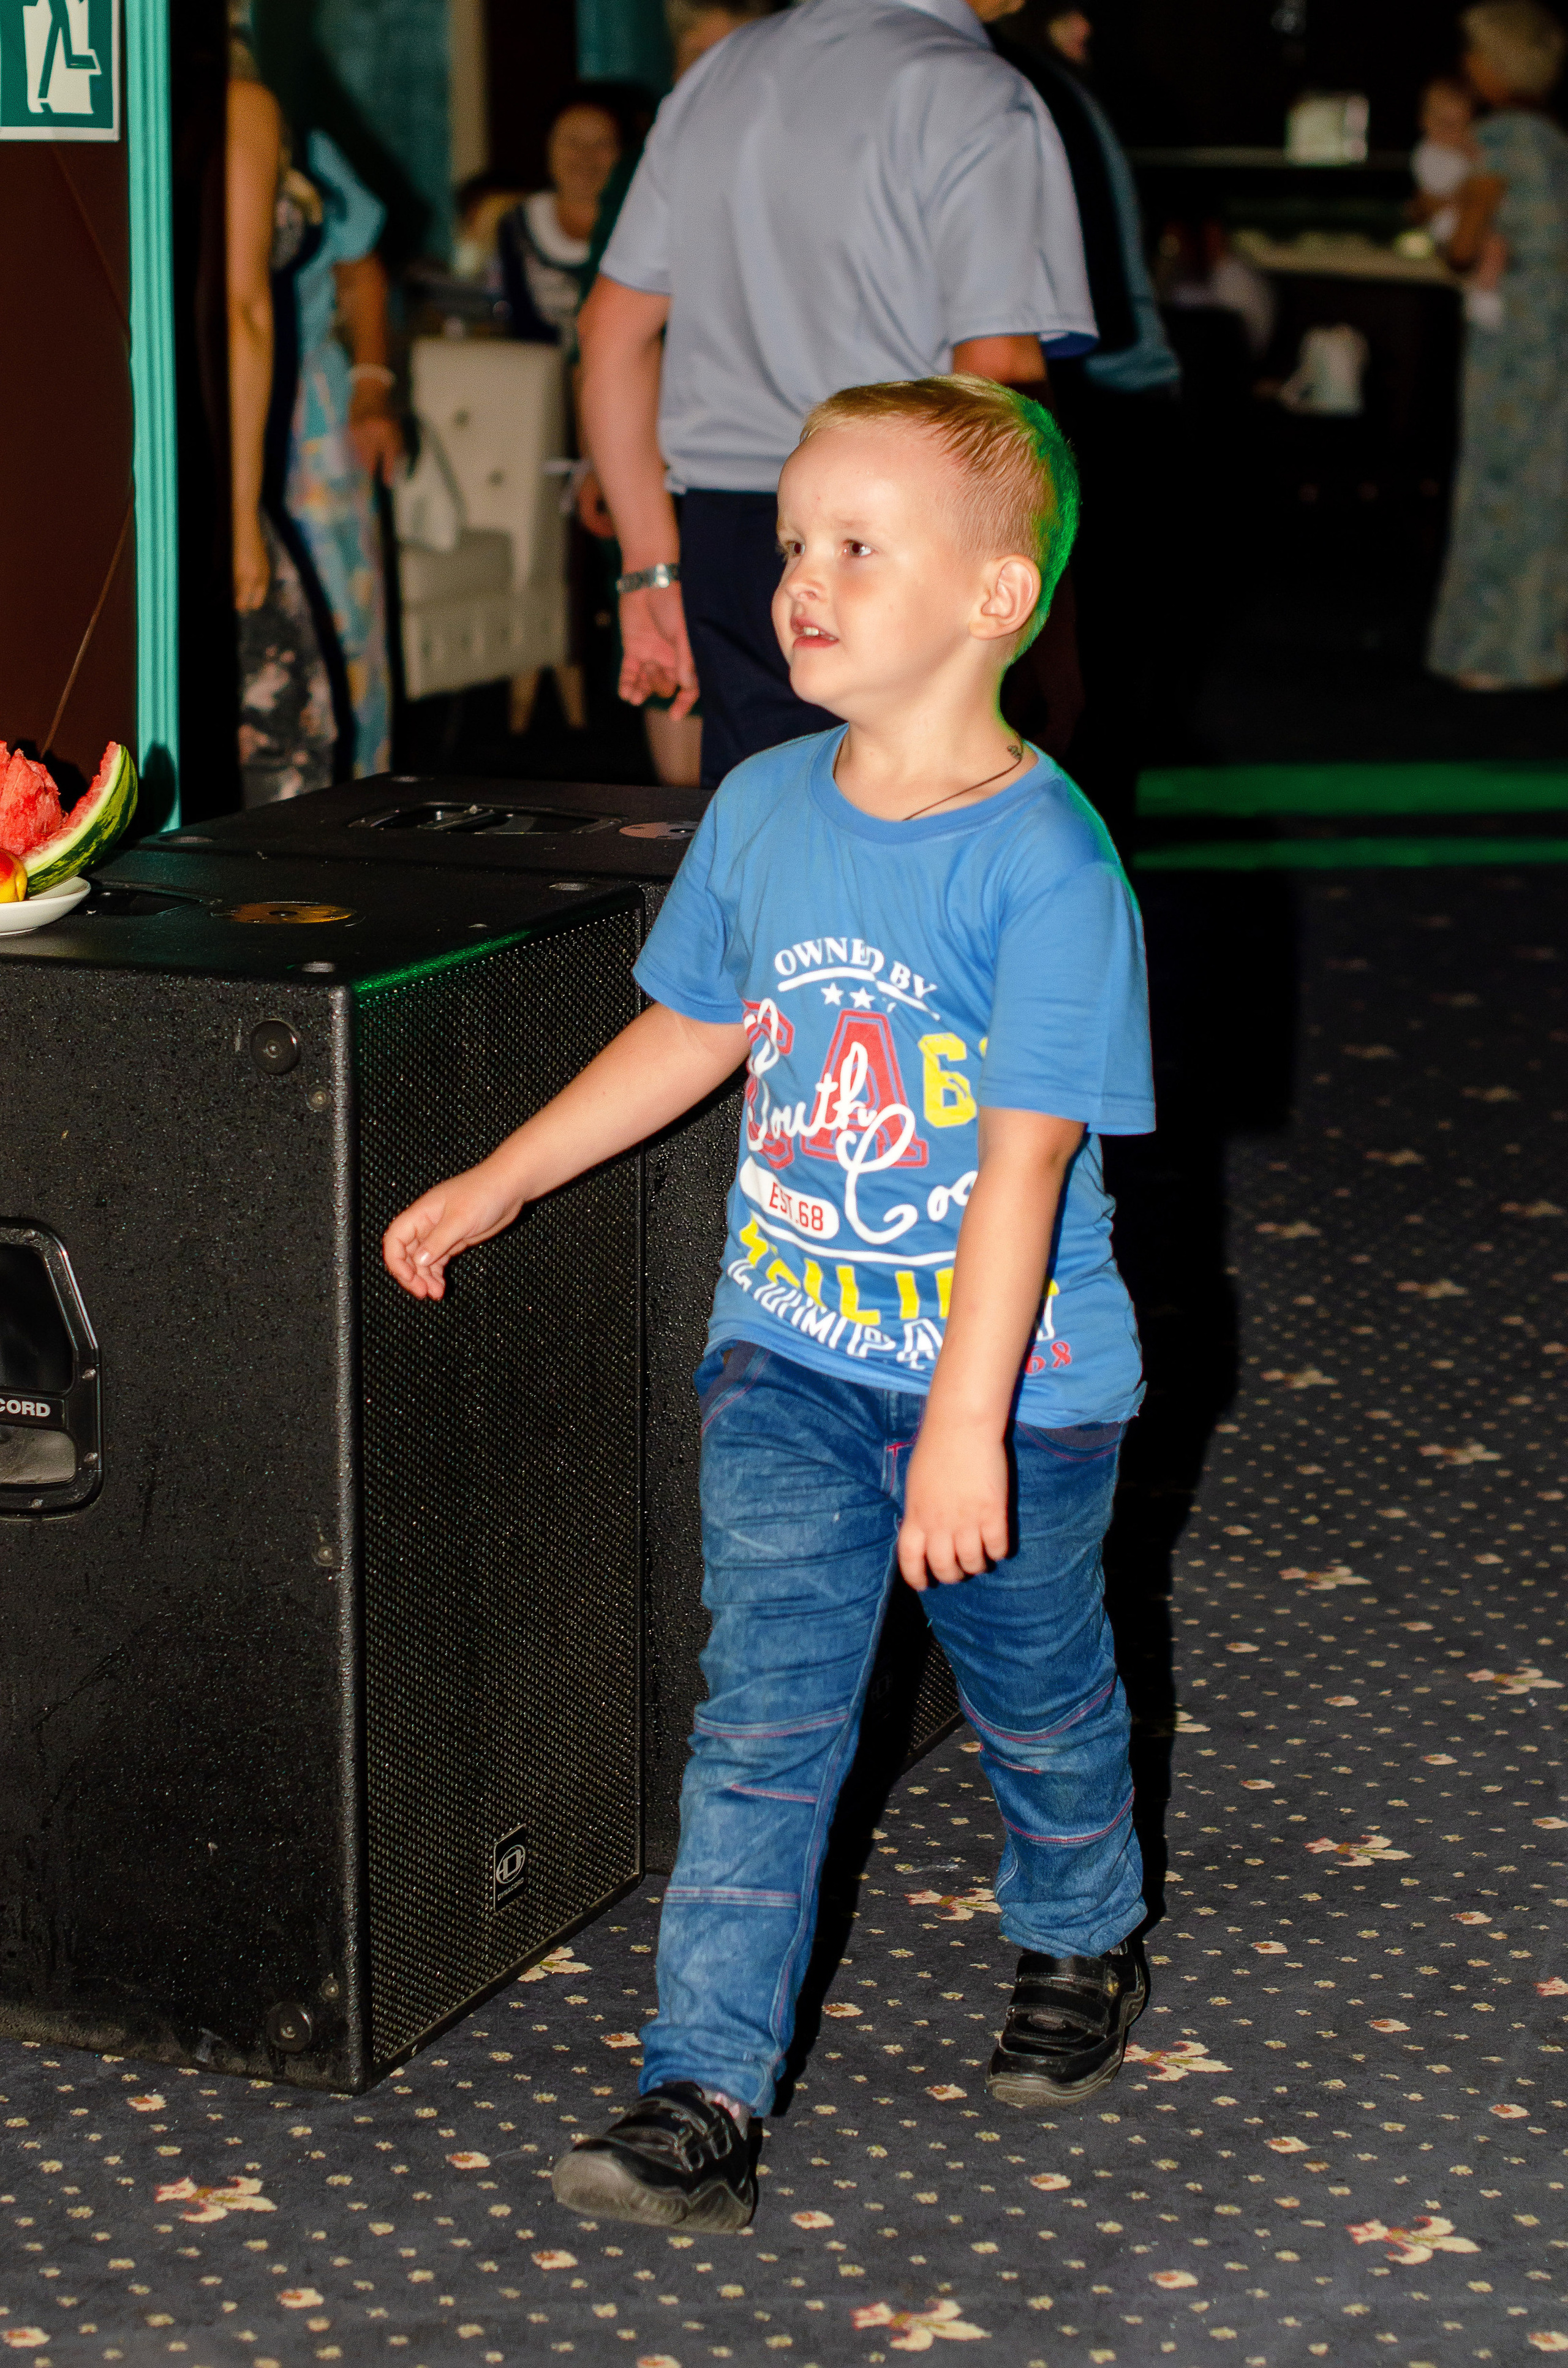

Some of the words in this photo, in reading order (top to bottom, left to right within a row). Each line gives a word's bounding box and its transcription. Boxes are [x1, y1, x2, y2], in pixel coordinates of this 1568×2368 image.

[774, 937, 885, 976] OWNED
[890, 960, 938, 999] BY
[769, 1181, 824, 1232] EST.68
